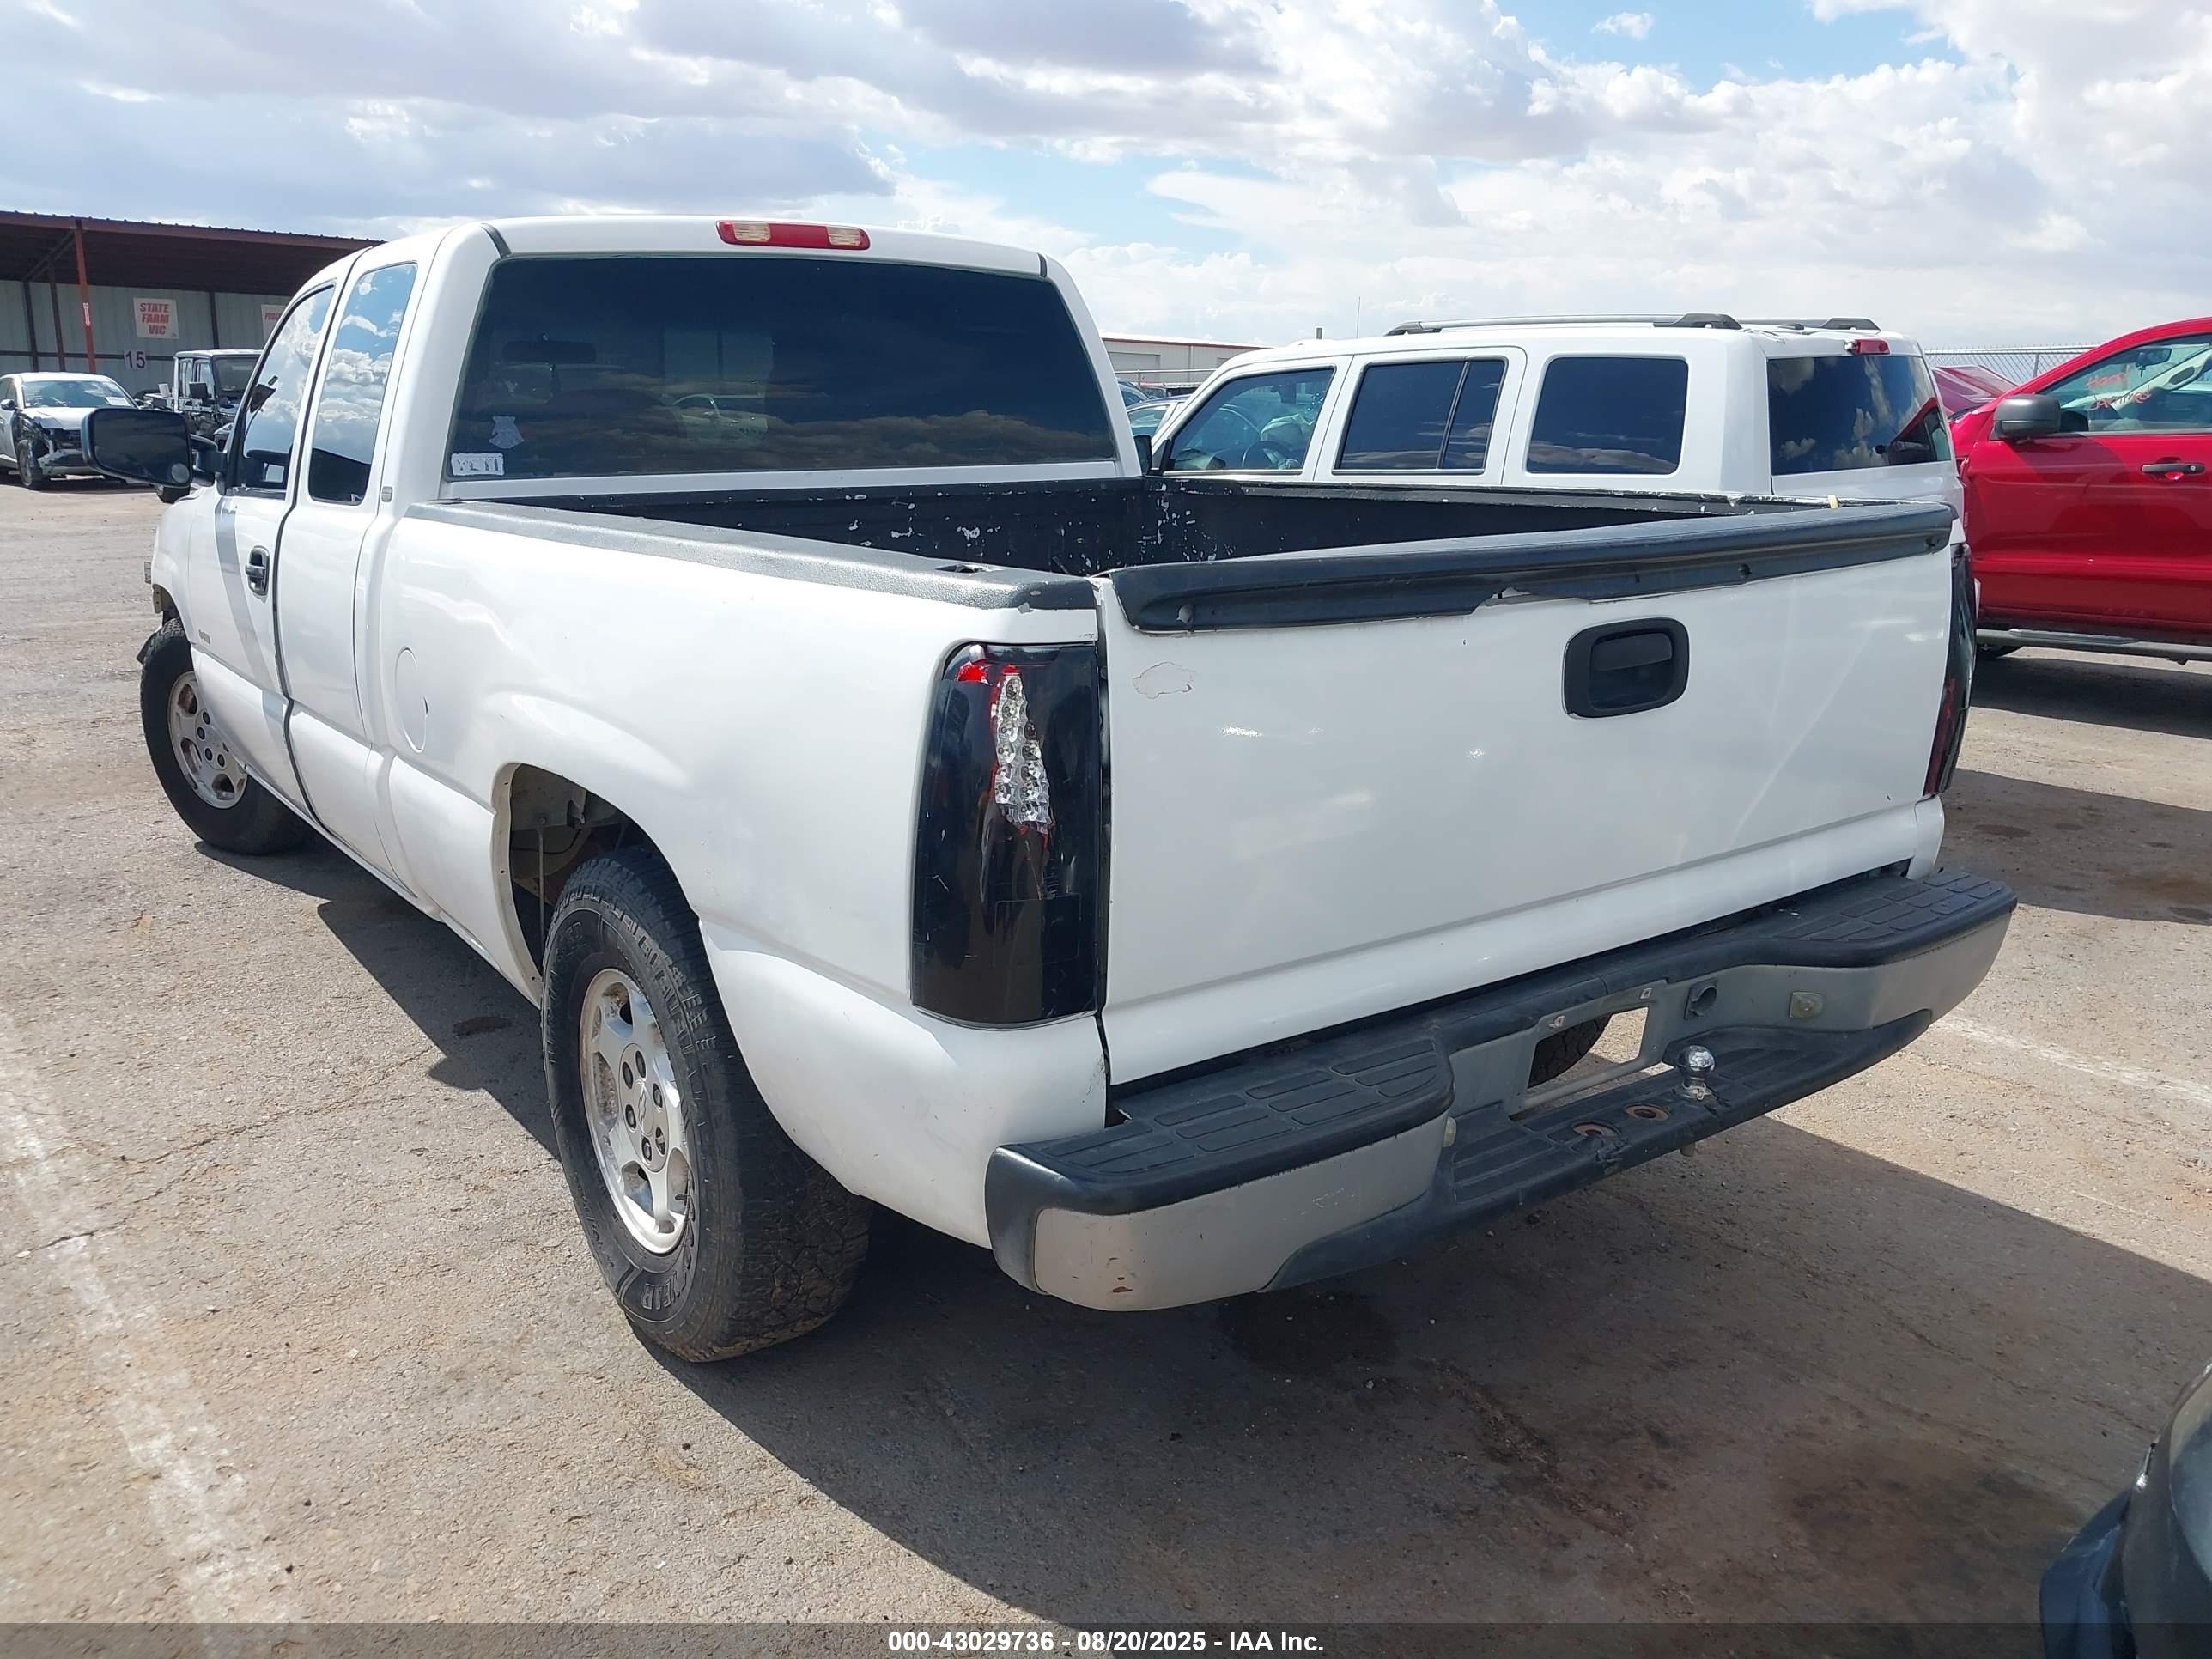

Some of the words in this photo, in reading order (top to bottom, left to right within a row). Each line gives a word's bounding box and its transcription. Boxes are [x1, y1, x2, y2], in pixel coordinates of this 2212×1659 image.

[139, 302, 170, 313] STATE
[142, 313, 170, 324] FARM
[149, 325, 167, 335] VIC
[125, 350, 146, 369] 15
